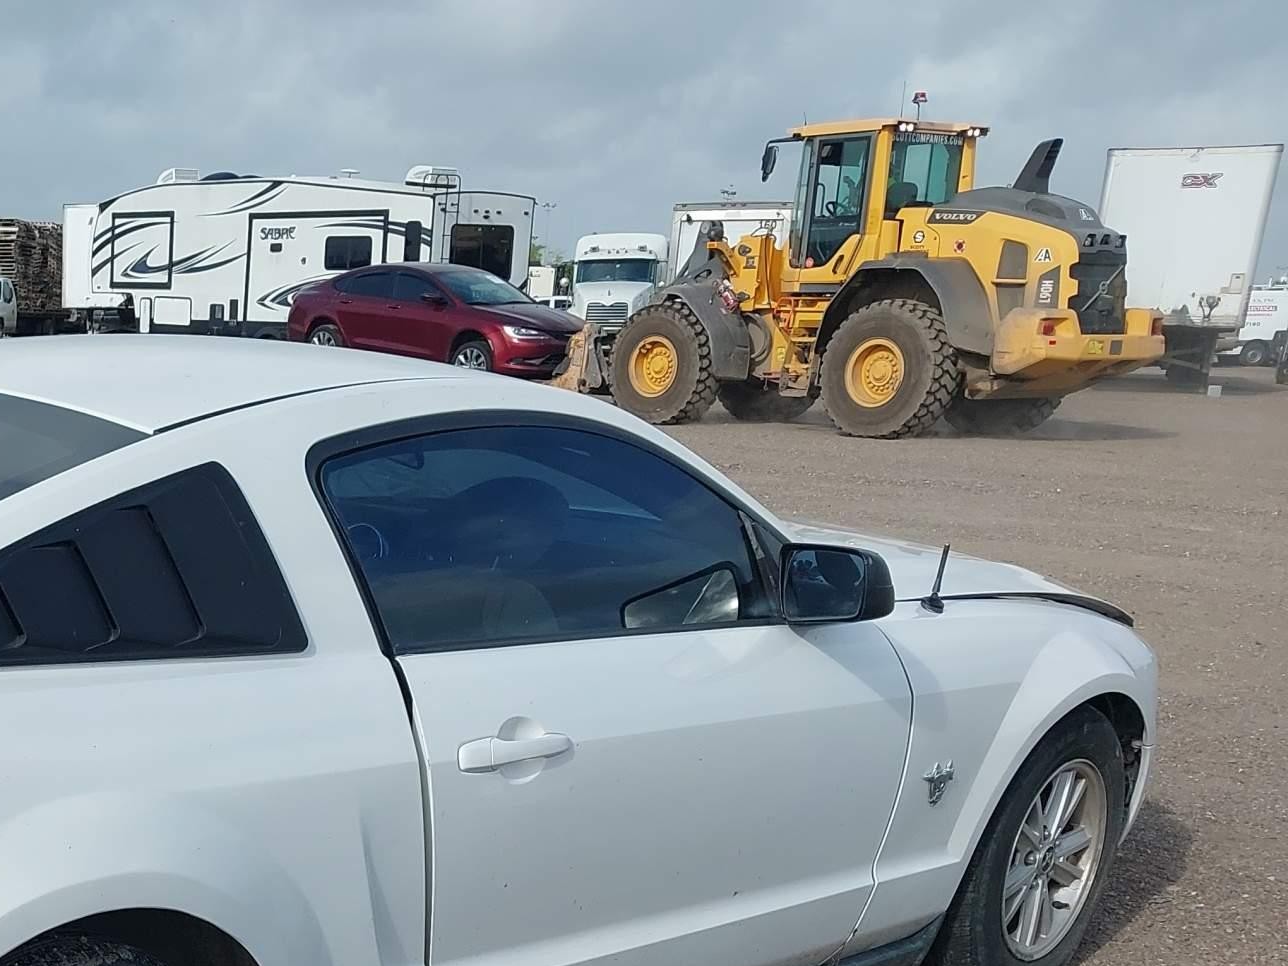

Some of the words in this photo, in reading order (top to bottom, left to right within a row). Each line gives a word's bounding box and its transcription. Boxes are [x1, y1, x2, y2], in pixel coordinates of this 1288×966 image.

[934, 212, 977, 221] VOLVO
[260, 226, 296, 240] SABRE
[1038, 279, 1055, 304] L90H
